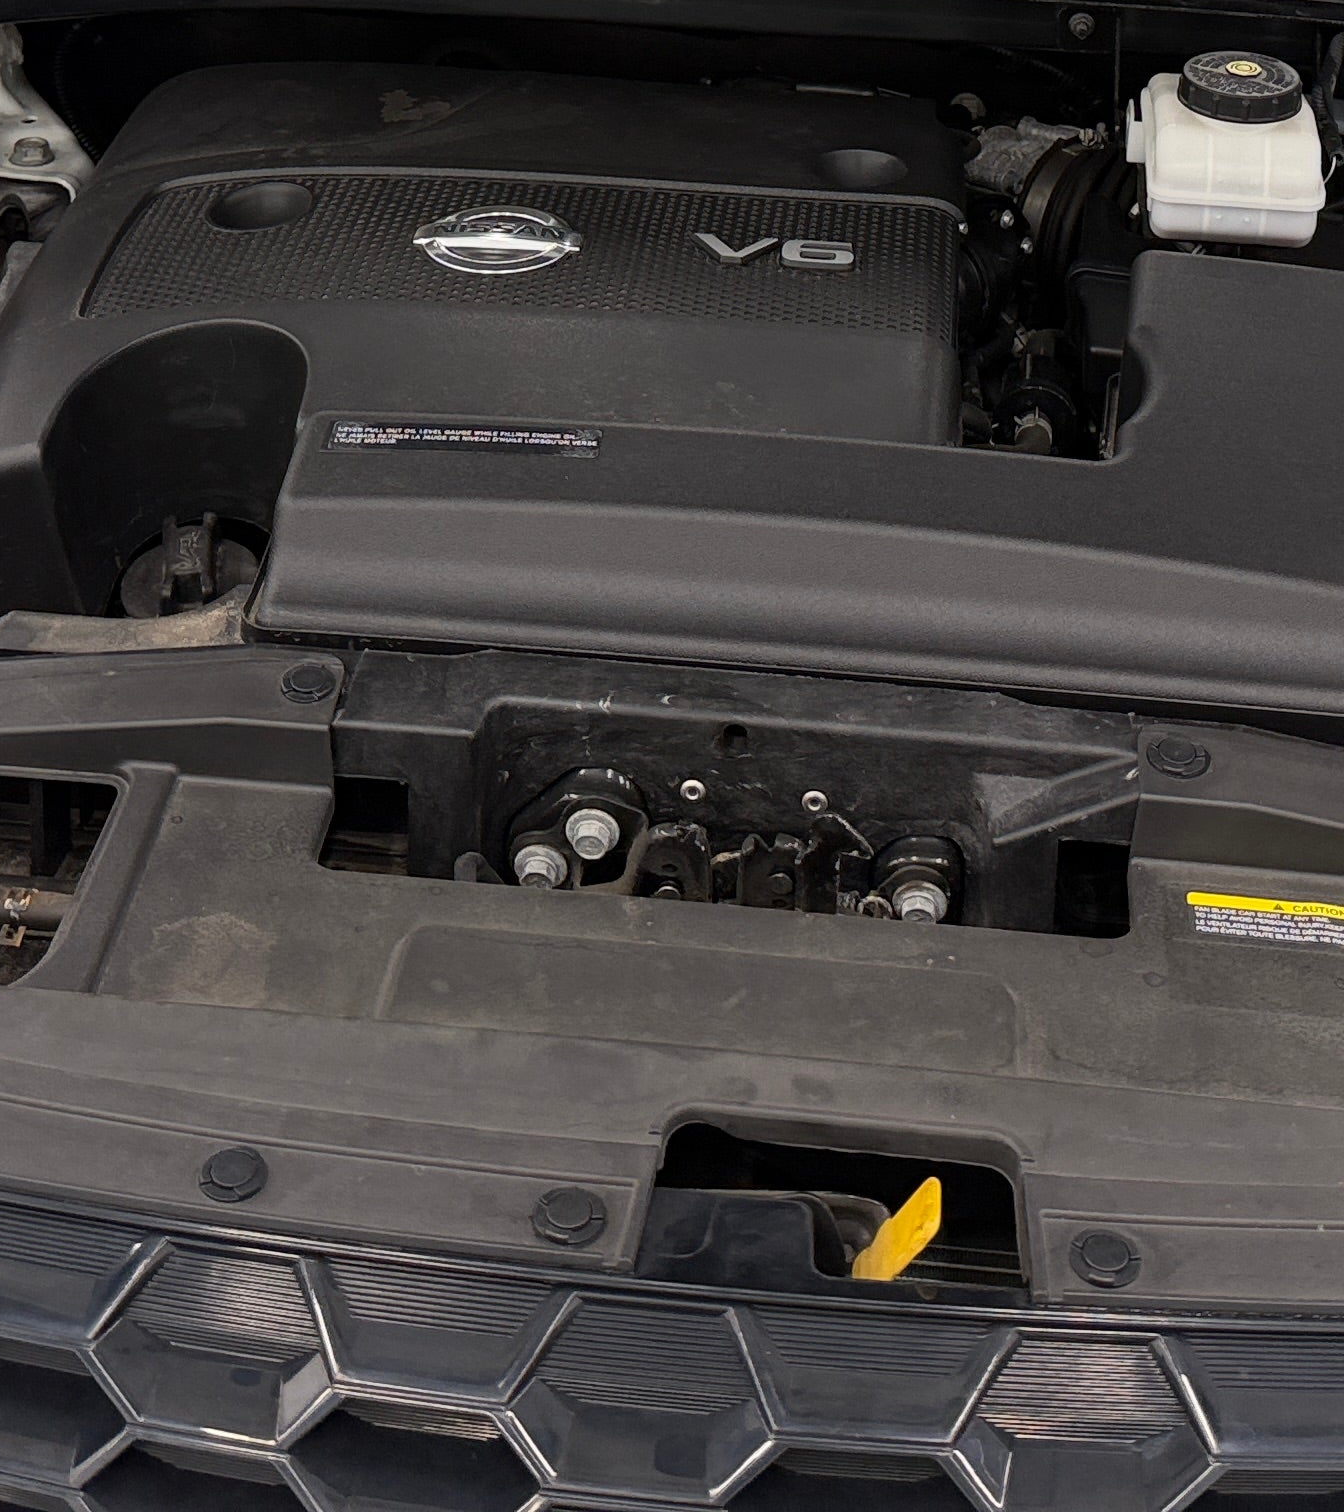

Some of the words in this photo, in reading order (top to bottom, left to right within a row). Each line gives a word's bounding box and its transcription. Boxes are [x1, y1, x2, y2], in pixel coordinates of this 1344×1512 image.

[434, 221, 565, 239] NISSAN
[691, 232, 855, 270] V6
[1229, 915, 1253, 923] AVOID
[1254, 918, 1297, 927] PERSONAL
[1257, 911, 1281, 919] START
[1207, 919, 1257, 930] VENTILATEUR
[1258, 925, 1288, 934] RISQUE
[1248, 931, 1274, 939] TOUTE
